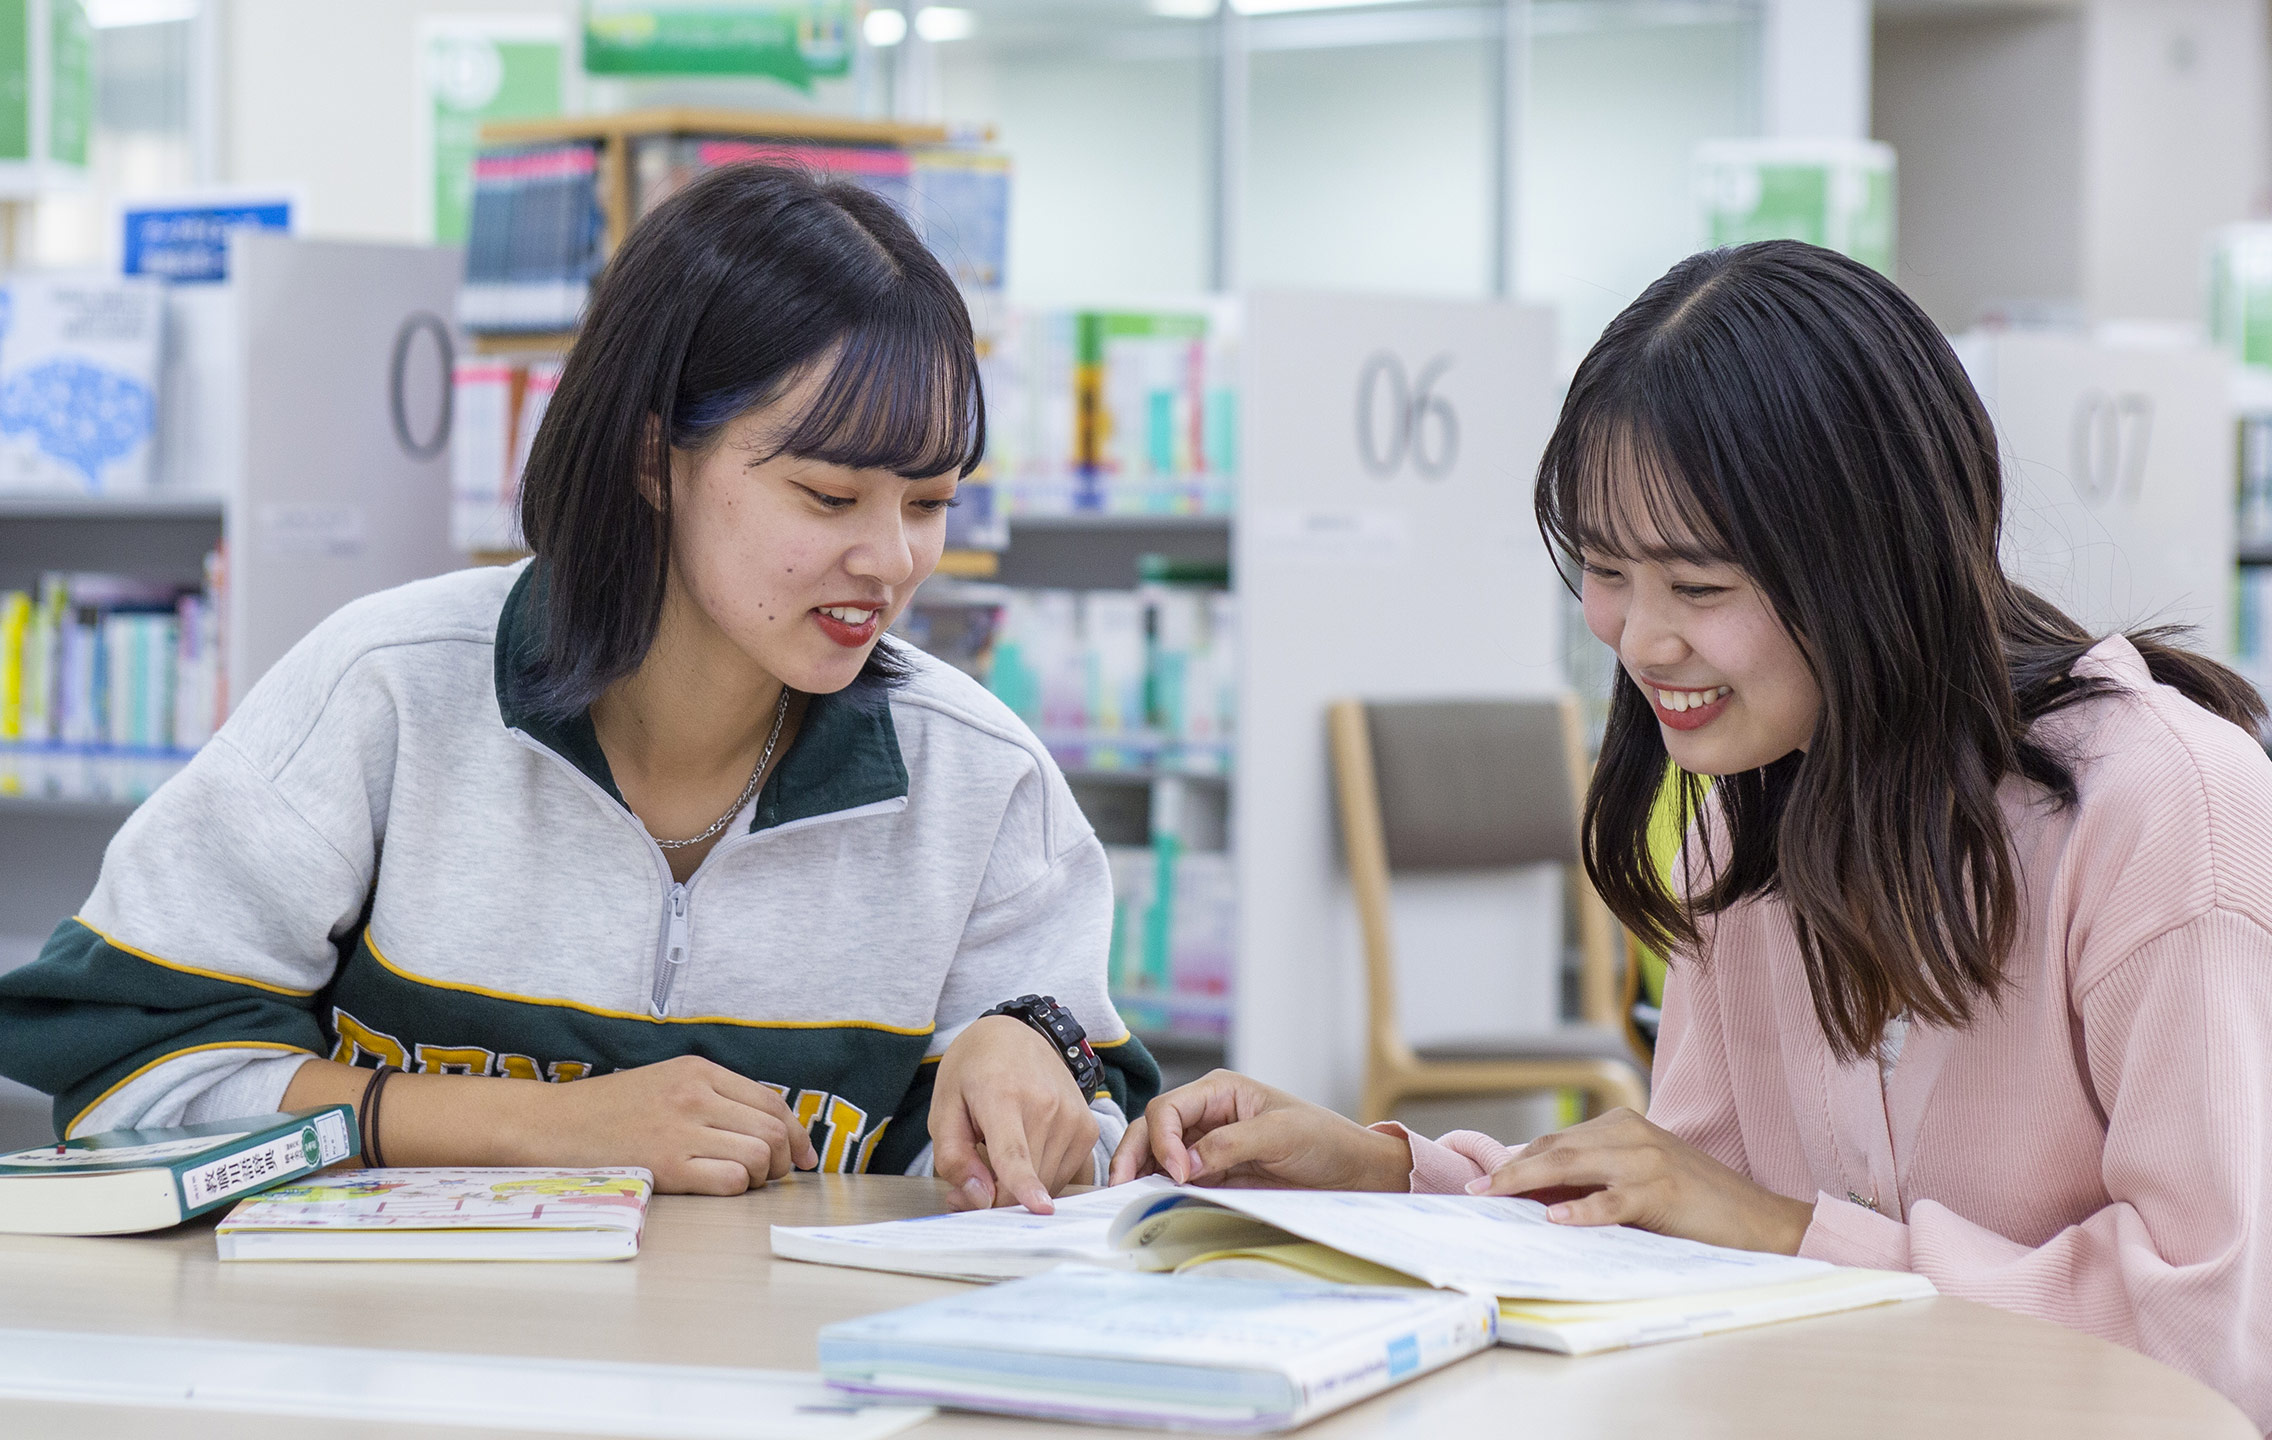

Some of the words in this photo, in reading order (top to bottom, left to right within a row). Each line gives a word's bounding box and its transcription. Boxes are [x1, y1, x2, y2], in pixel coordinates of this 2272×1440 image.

[1355, 349, 1461, 480] 06
[2069, 386, 2155, 508] 07
[204, 1149, 278, 1193] 教職用語辞典
